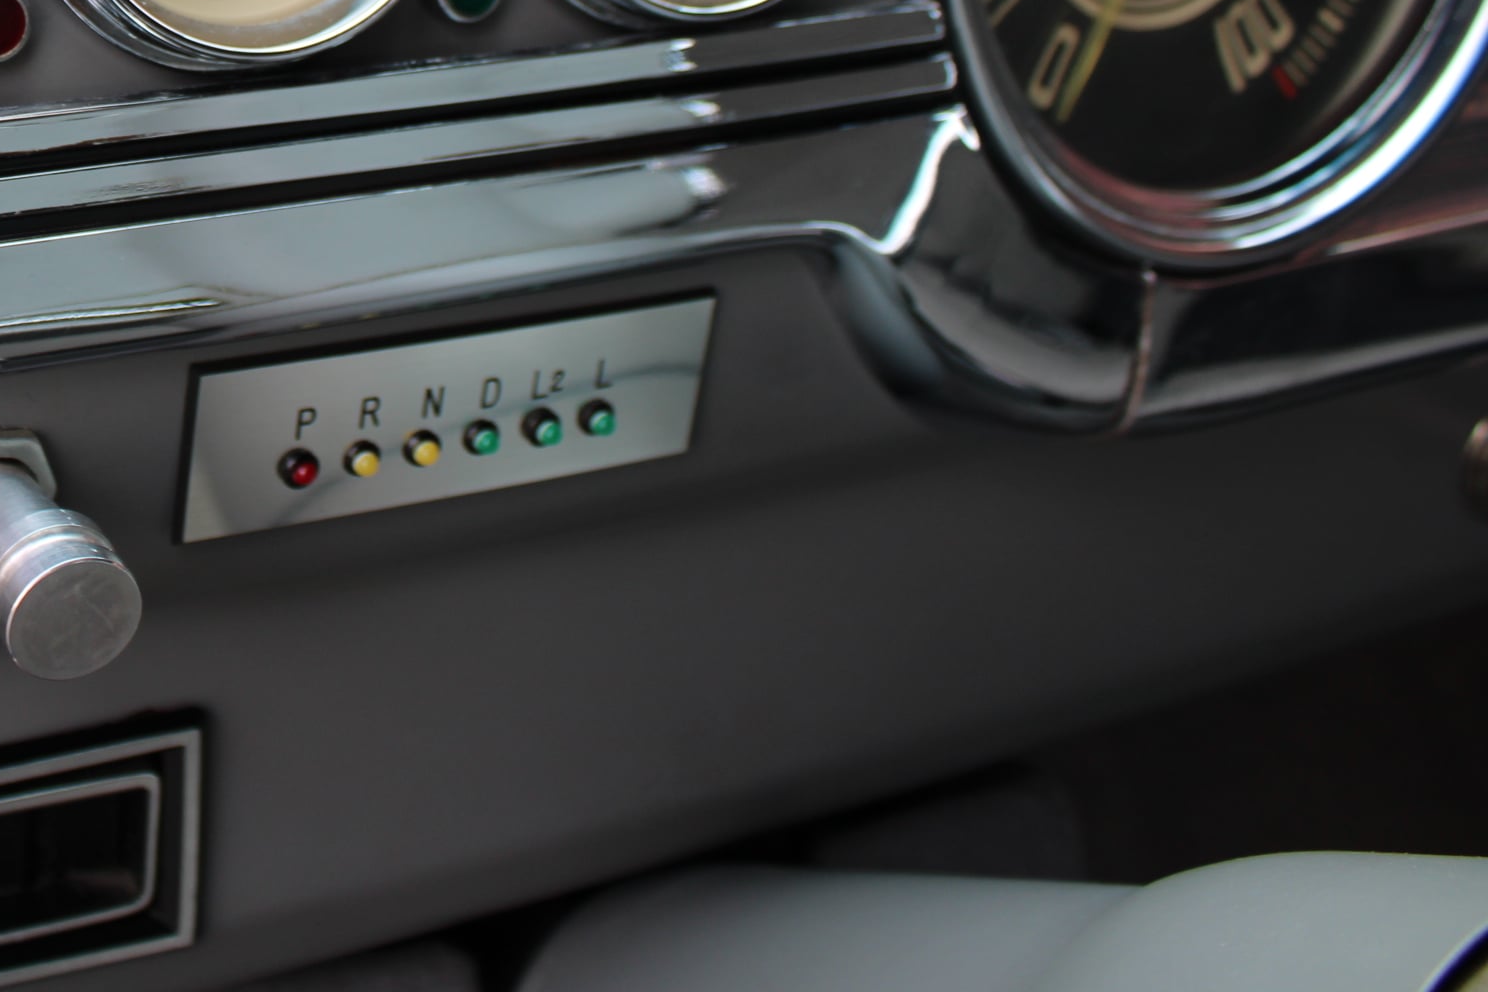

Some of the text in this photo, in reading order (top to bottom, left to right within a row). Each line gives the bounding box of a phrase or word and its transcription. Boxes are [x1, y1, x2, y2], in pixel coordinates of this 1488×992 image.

[1027, 23, 1079, 110] 0
[294, 407, 317, 441] P
[358, 396, 381, 430] R
[421, 386, 445, 419] N
[480, 376, 503, 409] D
[595, 358, 611, 390] L
